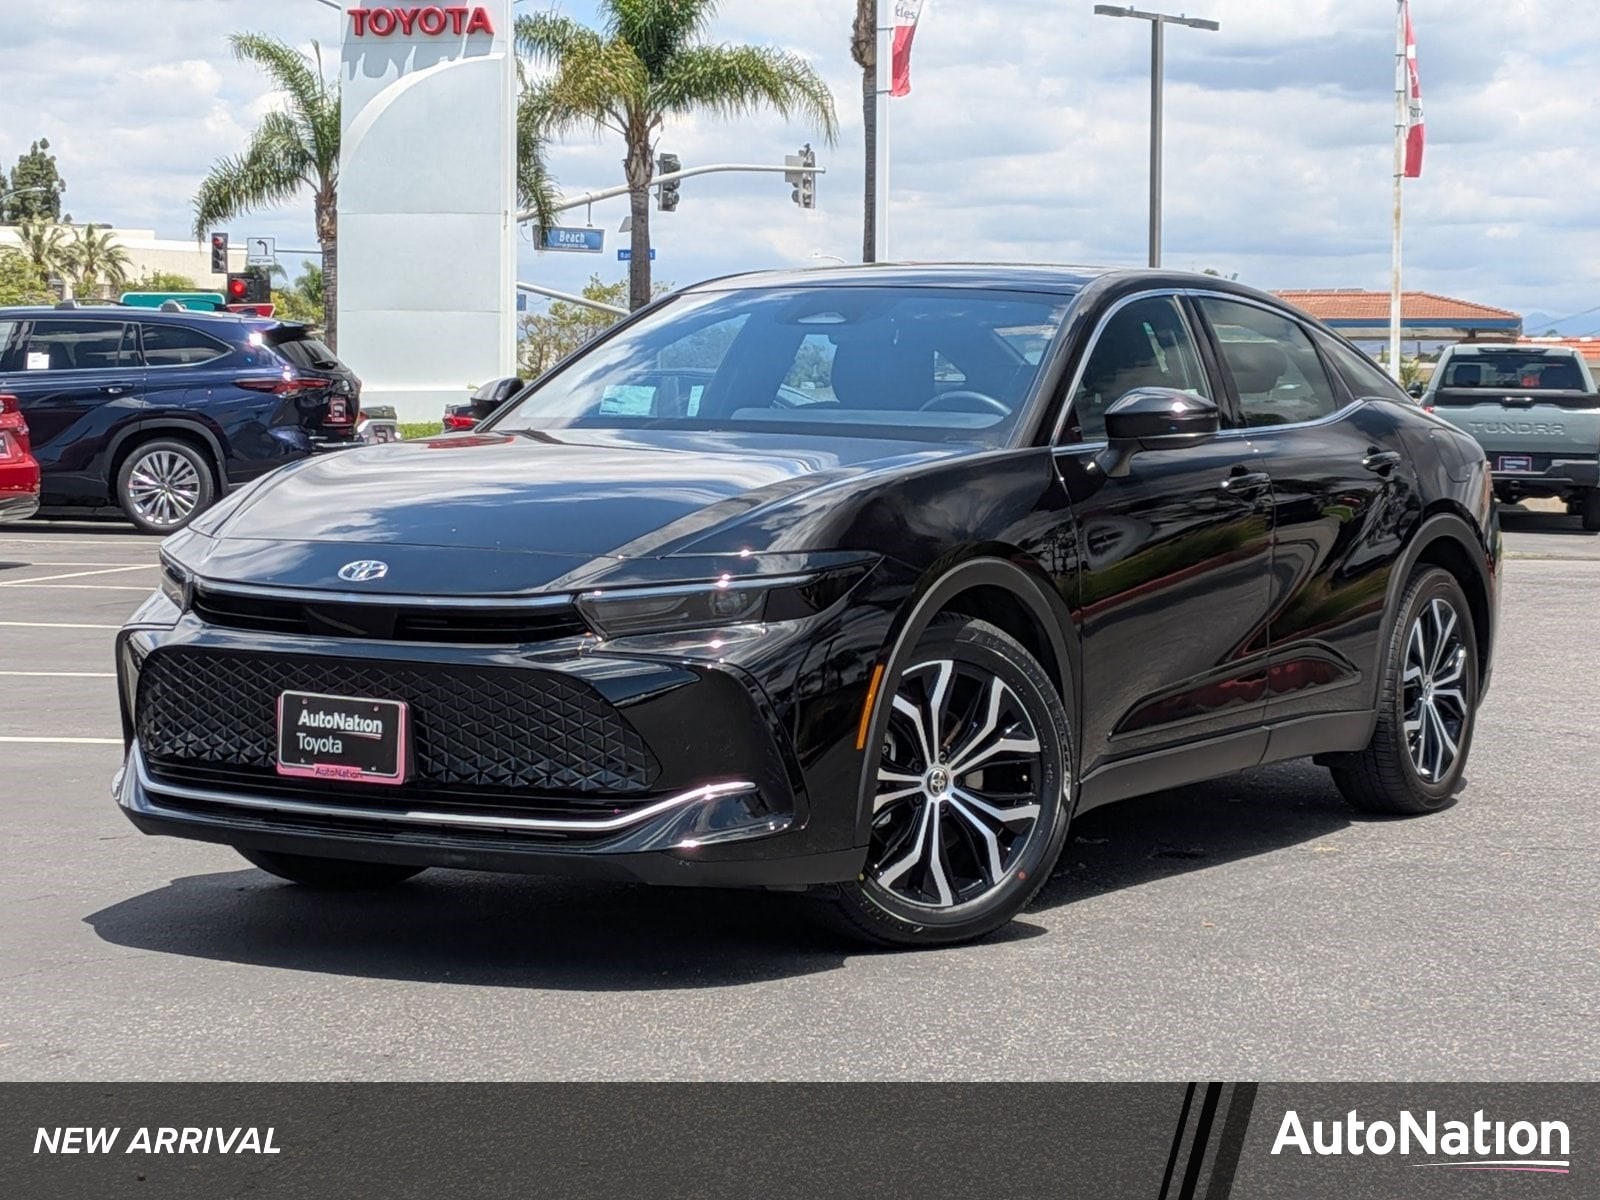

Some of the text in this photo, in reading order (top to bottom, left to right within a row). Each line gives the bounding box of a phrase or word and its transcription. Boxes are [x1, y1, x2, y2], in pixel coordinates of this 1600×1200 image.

[347, 6, 494, 37] TOYOTA
[559, 230, 585, 243] Beach
[1468, 422, 1565, 436] TUNDRA
[298, 709, 383, 734] AutoNation
[296, 732, 343, 755] Toyota
[315, 766, 364, 780] AutoNation
